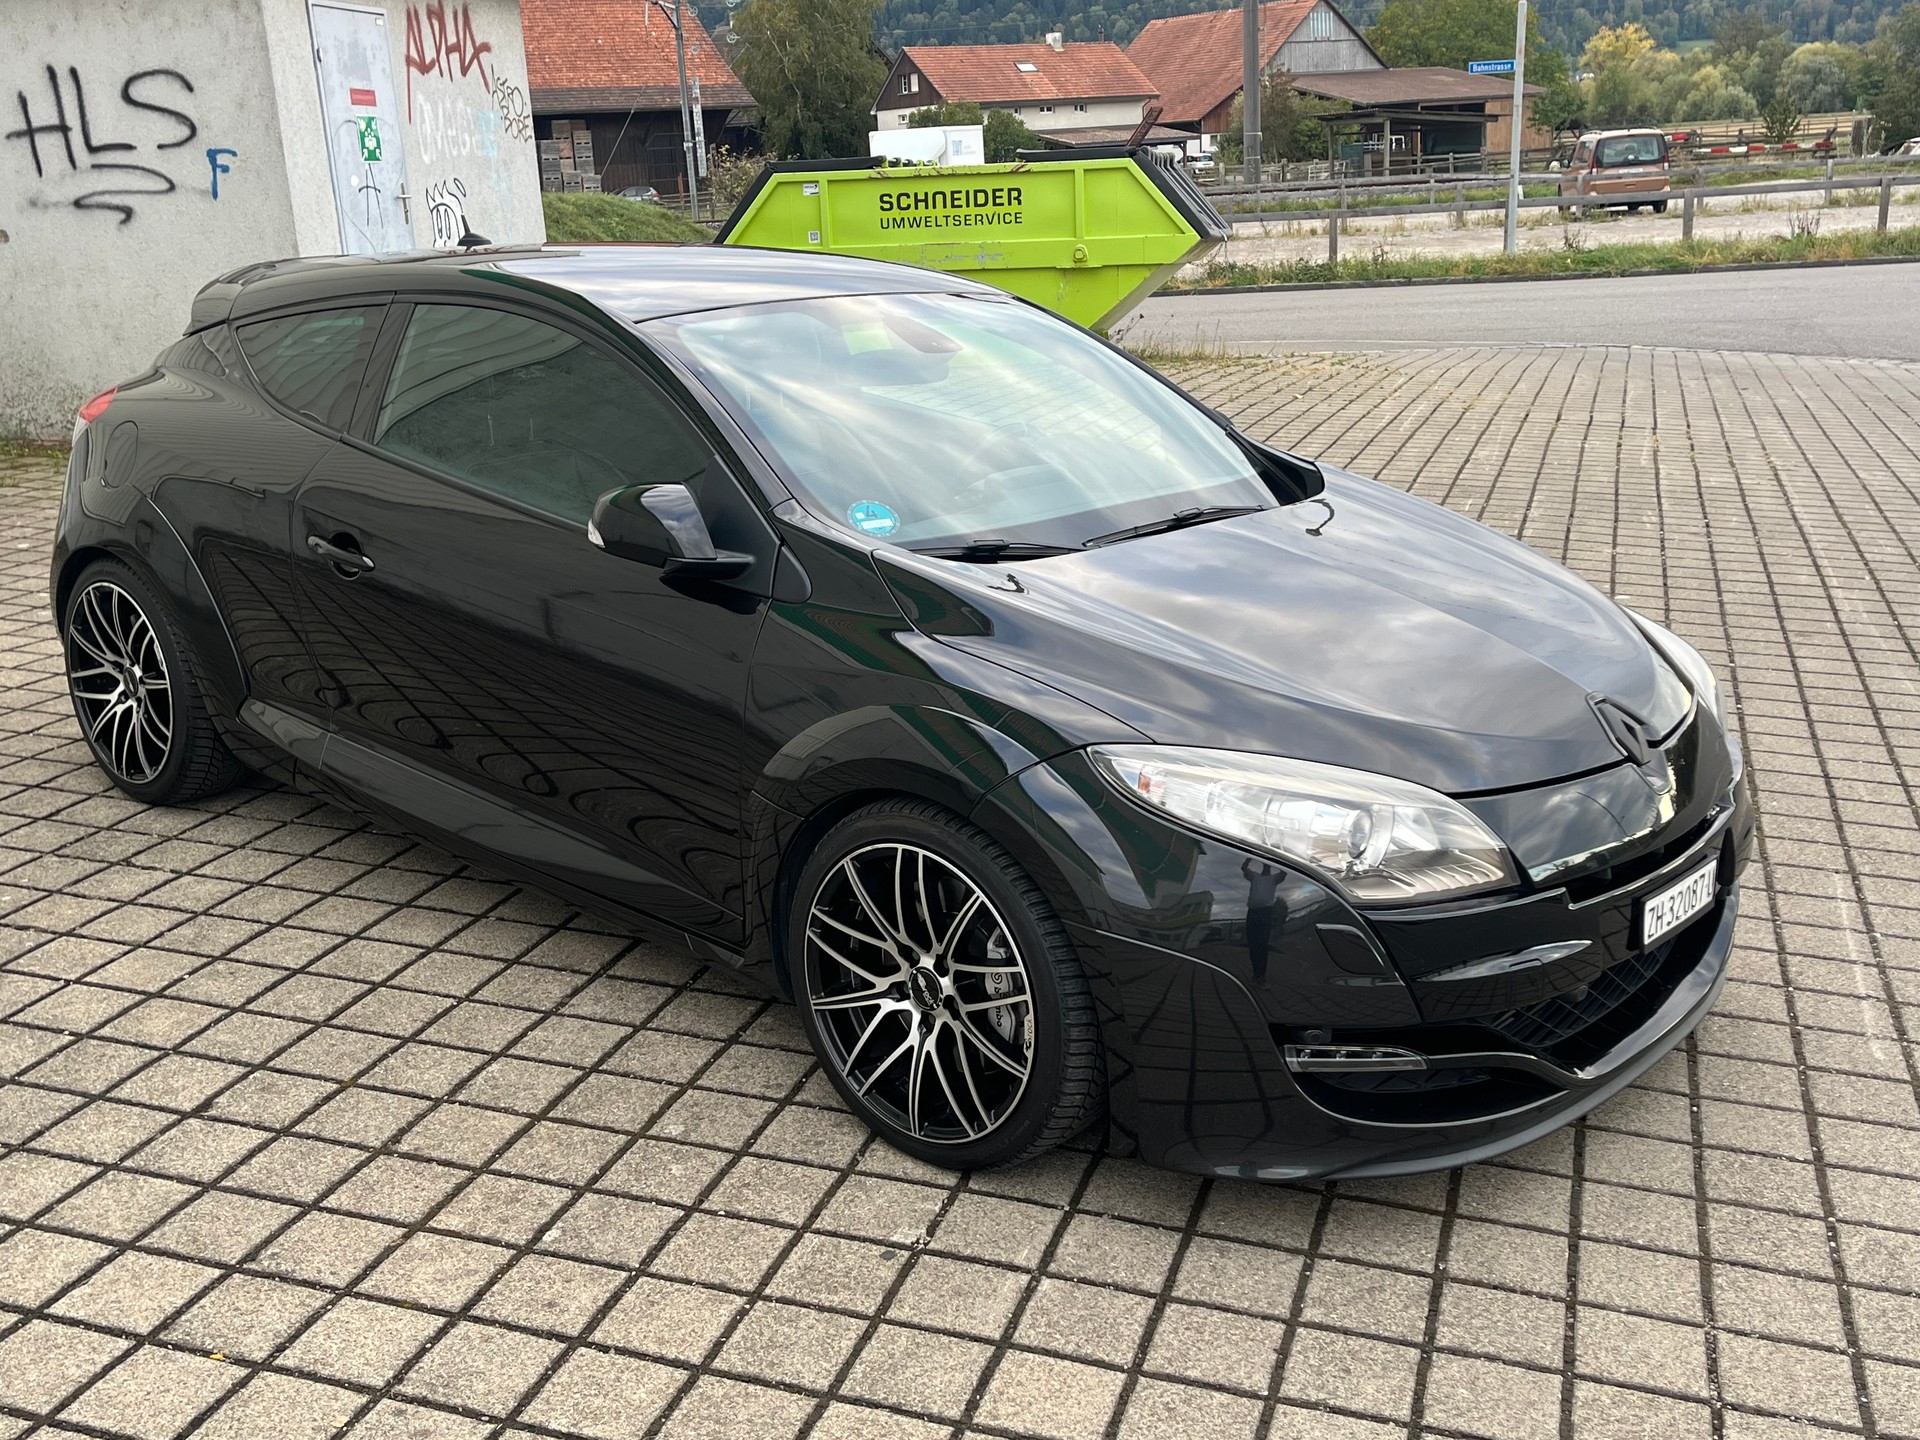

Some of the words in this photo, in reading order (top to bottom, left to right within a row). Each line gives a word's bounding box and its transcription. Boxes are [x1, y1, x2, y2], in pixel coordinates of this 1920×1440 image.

[404, 0, 492, 124] ALPHA
[1472, 62, 1512, 73] Bahnstrasse
[5, 64, 197, 177] HLS
[206, 148, 239, 199] F
[879, 187, 1023, 212] SCHNEIDER
[880, 212, 1023, 230] UMWELTSERVICE
